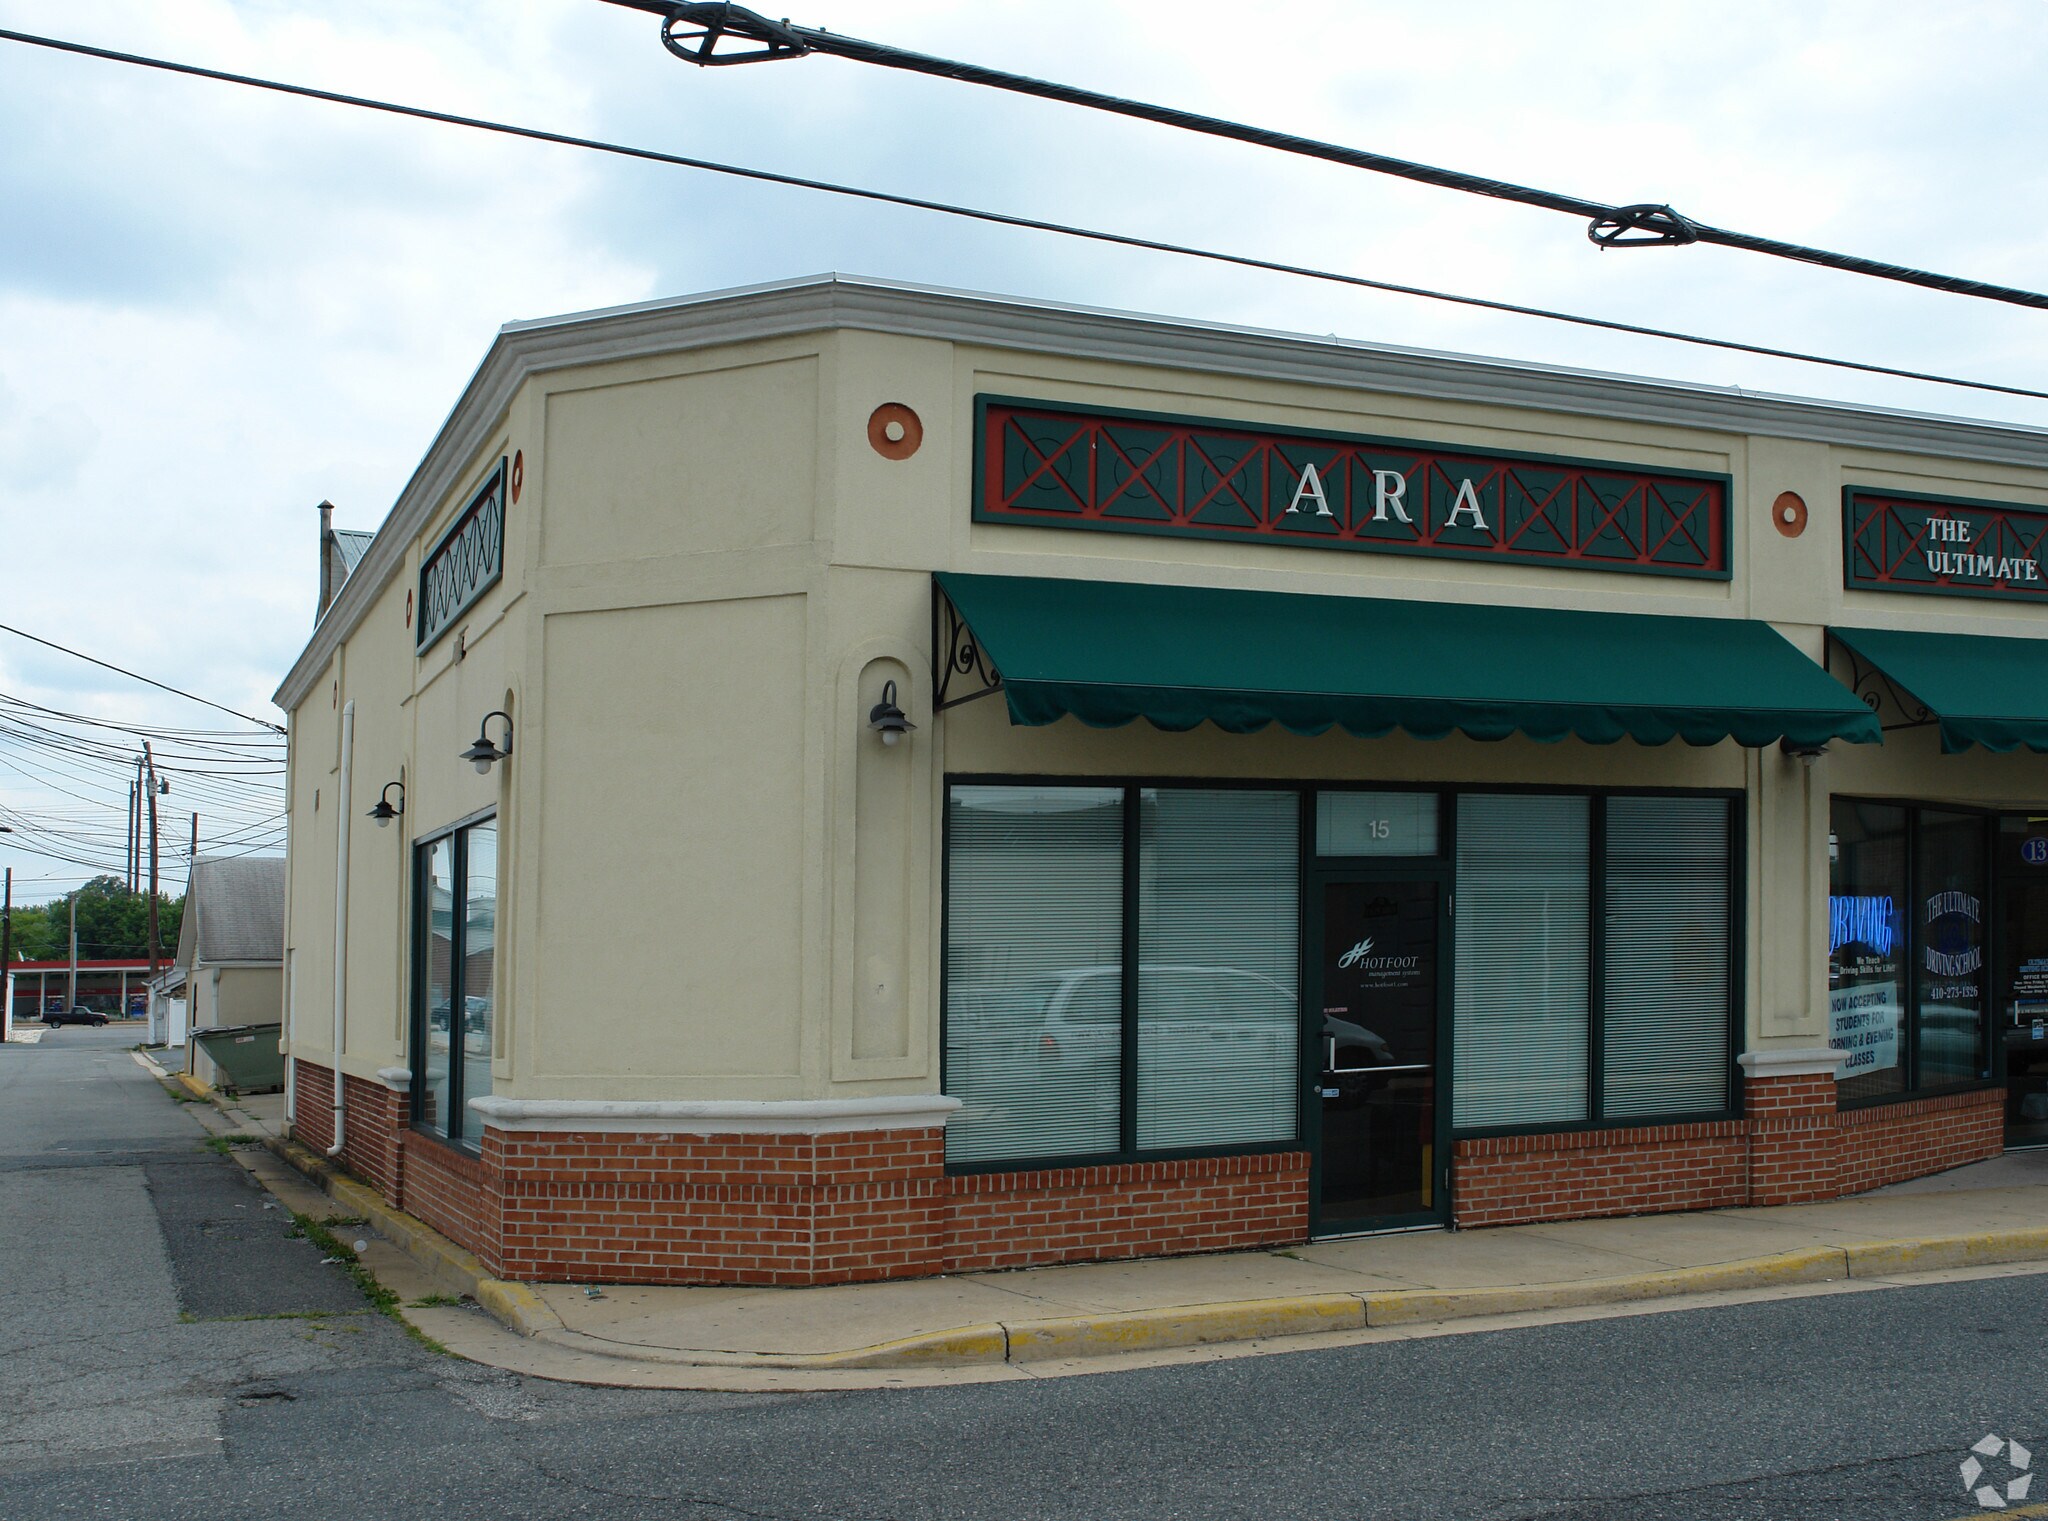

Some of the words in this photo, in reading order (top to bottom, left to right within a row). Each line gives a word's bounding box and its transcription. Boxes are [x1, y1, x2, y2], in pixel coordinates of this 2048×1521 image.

[1926, 517, 1971, 543] THE
[1926, 550, 2039, 581] ULTIMATE
[1369, 820, 1390, 839] 15
[2030, 840, 2048, 861] 13
[1926, 892, 1943, 924] THE
[1943, 891, 1981, 924] ULTIMATE
[1829, 896, 1893, 957] DRIVING
[1360, 956, 1419, 969] HOTFOOT
[1840, 966, 1859, 976] Driving
[1860, 965, 1874, 973] Skills
[1856, 956, 1865, 965] We
[1925, 945, 1955, 976] DRIVING
[1954, 945, 1982, 976] SCHOOL
[1831, 997, 1847, 1012] NOW
[1849, 991, 1887, 1009] ACCEPTING
[1930, 985, 1979, 1000] 410-273-1326
[1836, 1013, 1870, 1031] STUDENTS
[1872, 1011, 1885, 1024] FOR
[1859, 1033, 1864, 1047] &
[1866, 1027, 1893, 1045] EVENING
